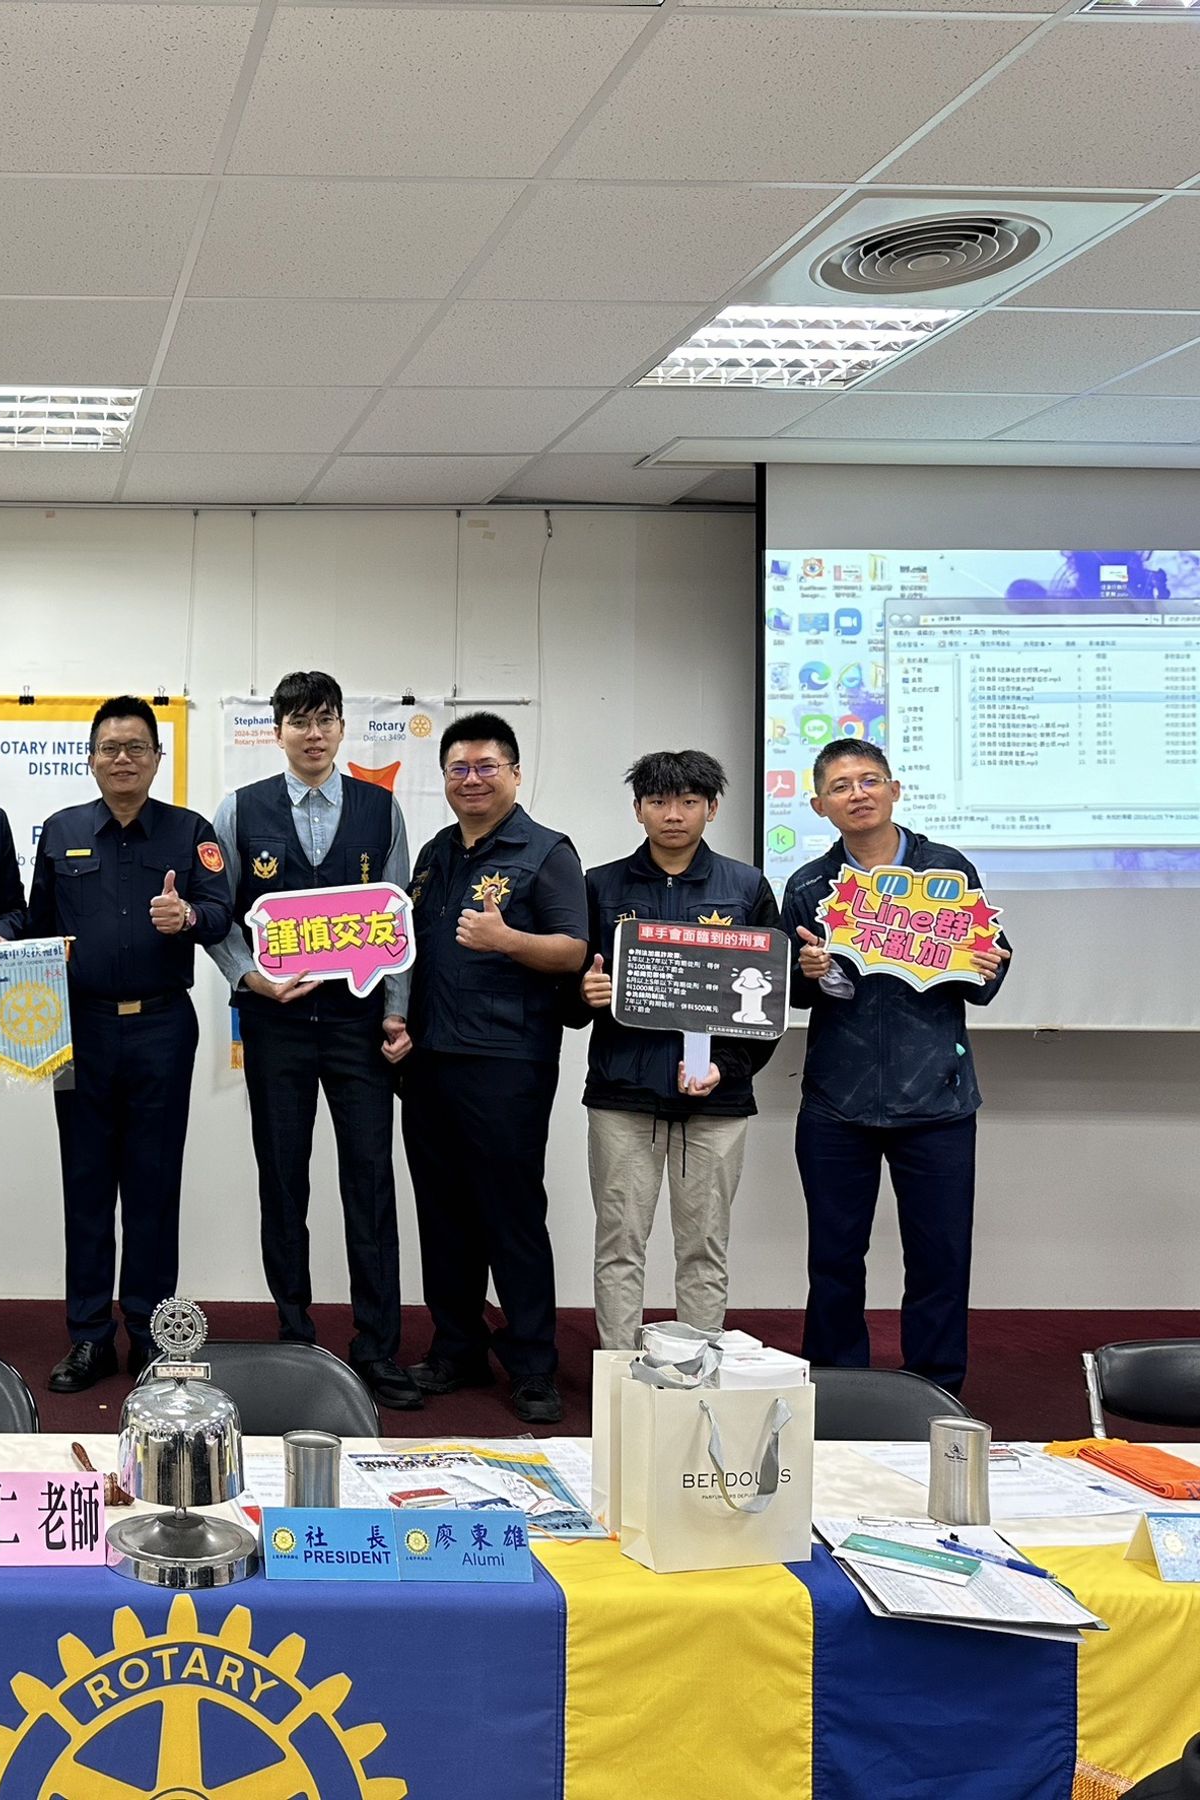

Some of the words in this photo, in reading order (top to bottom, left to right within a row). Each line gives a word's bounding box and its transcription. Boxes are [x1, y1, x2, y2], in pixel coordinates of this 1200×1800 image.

[363, 734, 387, 742] District
[388, 733, 407, 741] 3490
[368, 720, 406, 733] Rotary
[234, 738, 255, 747] Rotary
[28, 762, 90, 776] DISTRICT
[851, 889, 972, 941] Line群
[266, 911, 397, 957] 謹慎交友
[640, 925, 767, 949] 車手會面臨到的刑責
[851, 920, 952, 970] 不亂加
[37, 1480, 99, 1552] 老師
[435, 1523, 527, 1551] 廖東雄
[303, 1550, 391, 1564] PRESIDENT
[462, 1552, 505, 1566] Alumi
[83, 1646, 279, 1709] ROTARY
